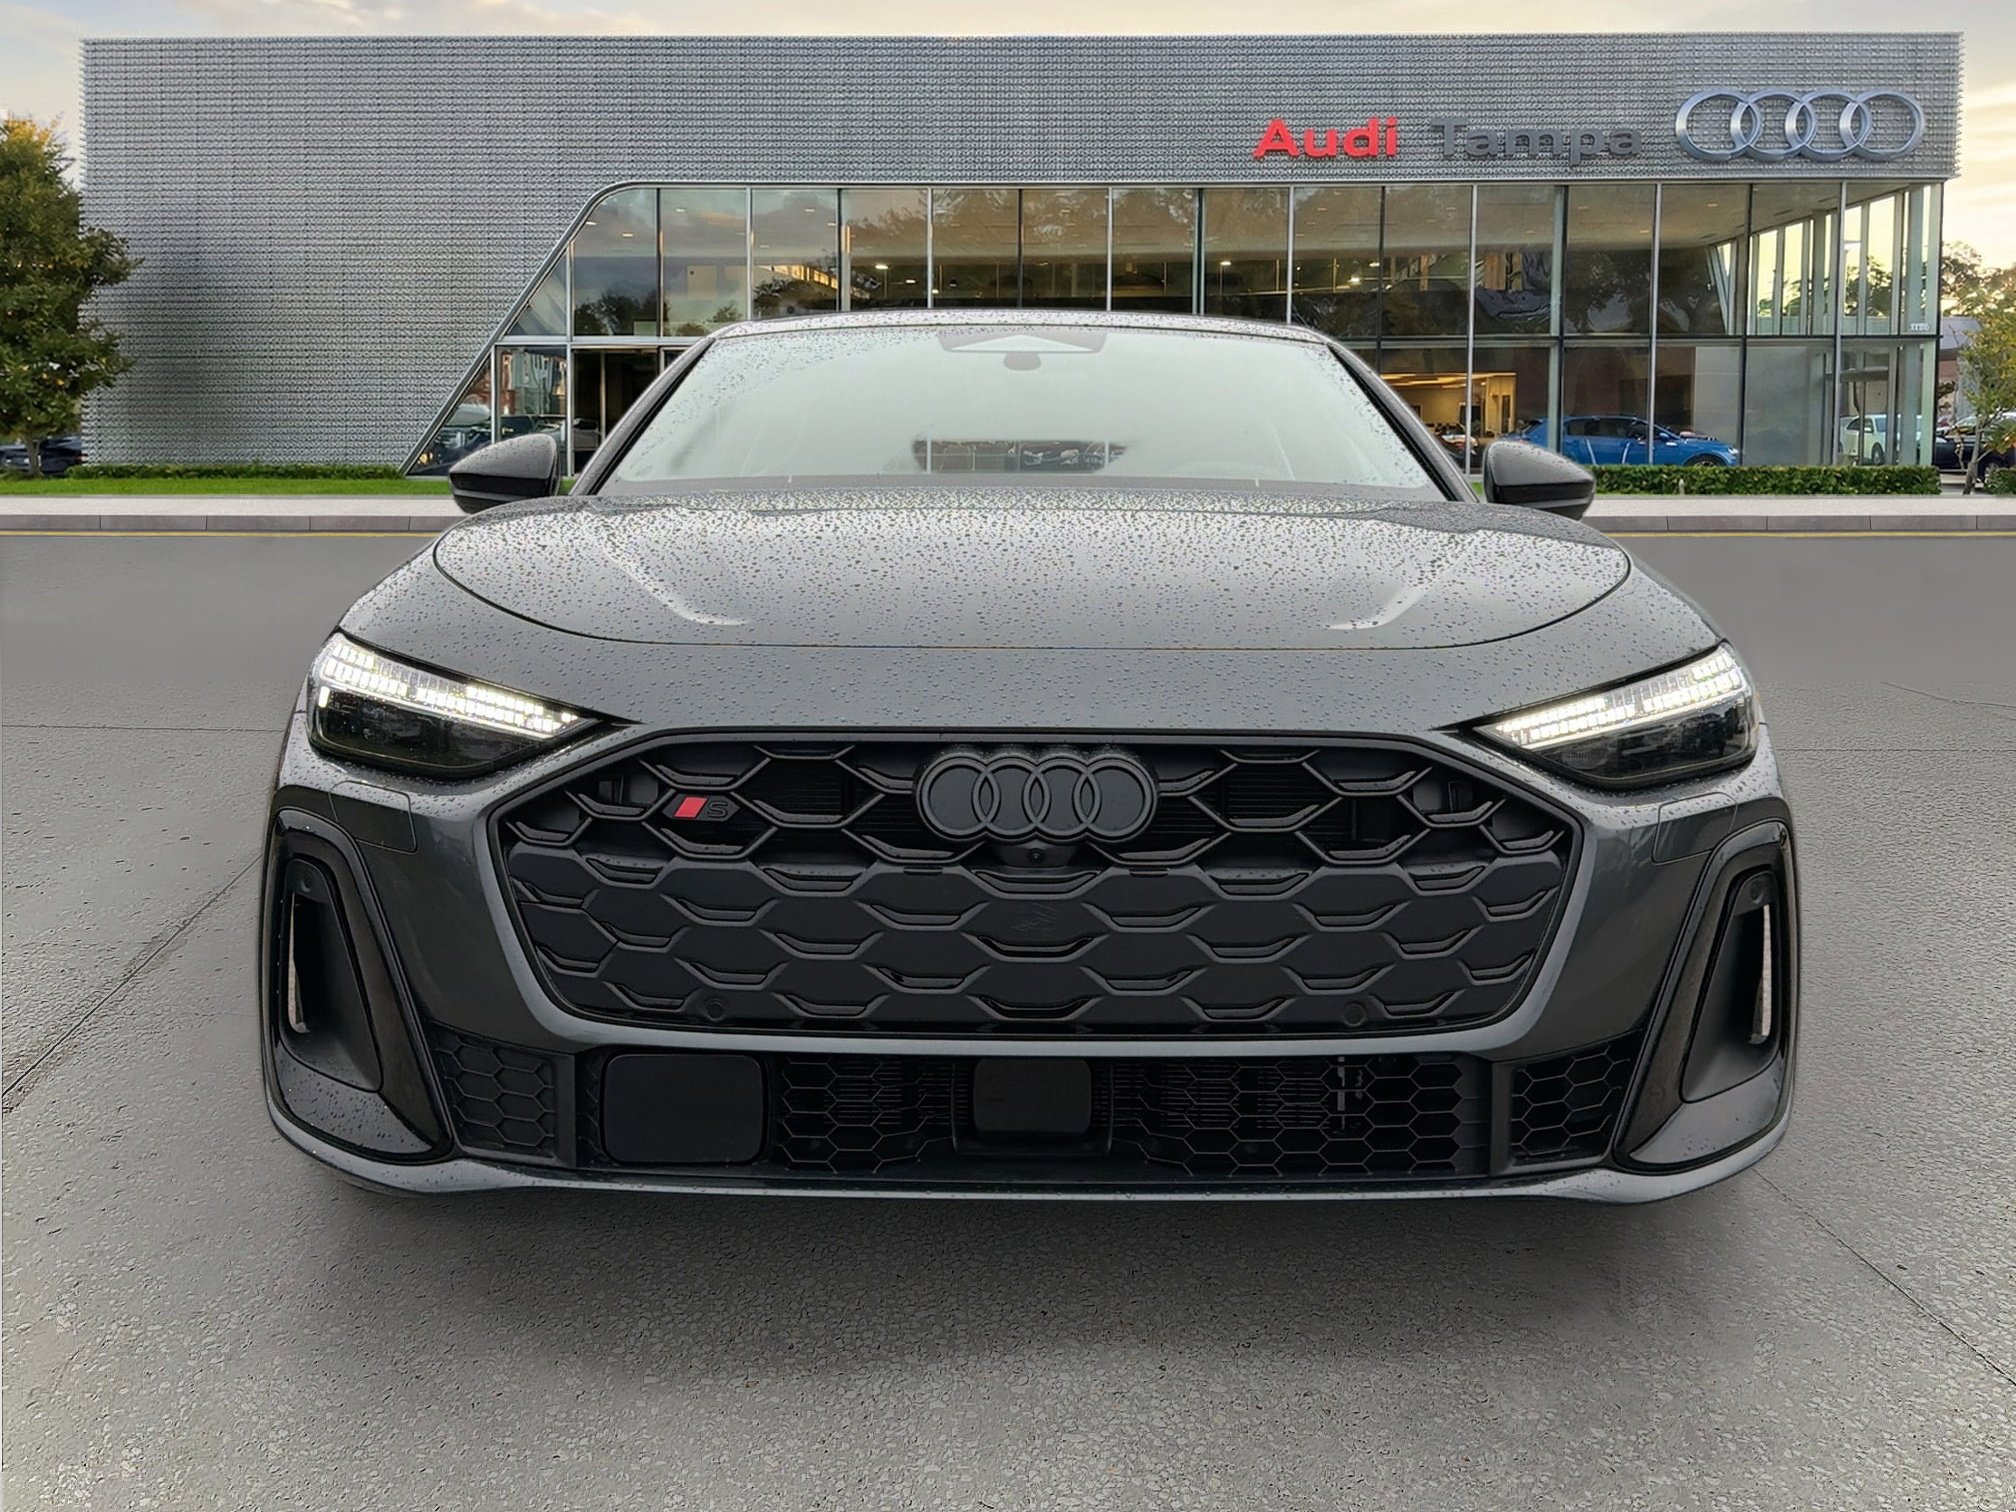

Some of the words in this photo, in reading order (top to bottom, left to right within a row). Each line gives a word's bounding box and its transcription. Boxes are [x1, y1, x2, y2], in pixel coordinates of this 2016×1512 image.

[1253, 116, 1398, 158] Audi
[1431, 116, 1642, 167] Tampa
[706, 800, 729, 819] S
